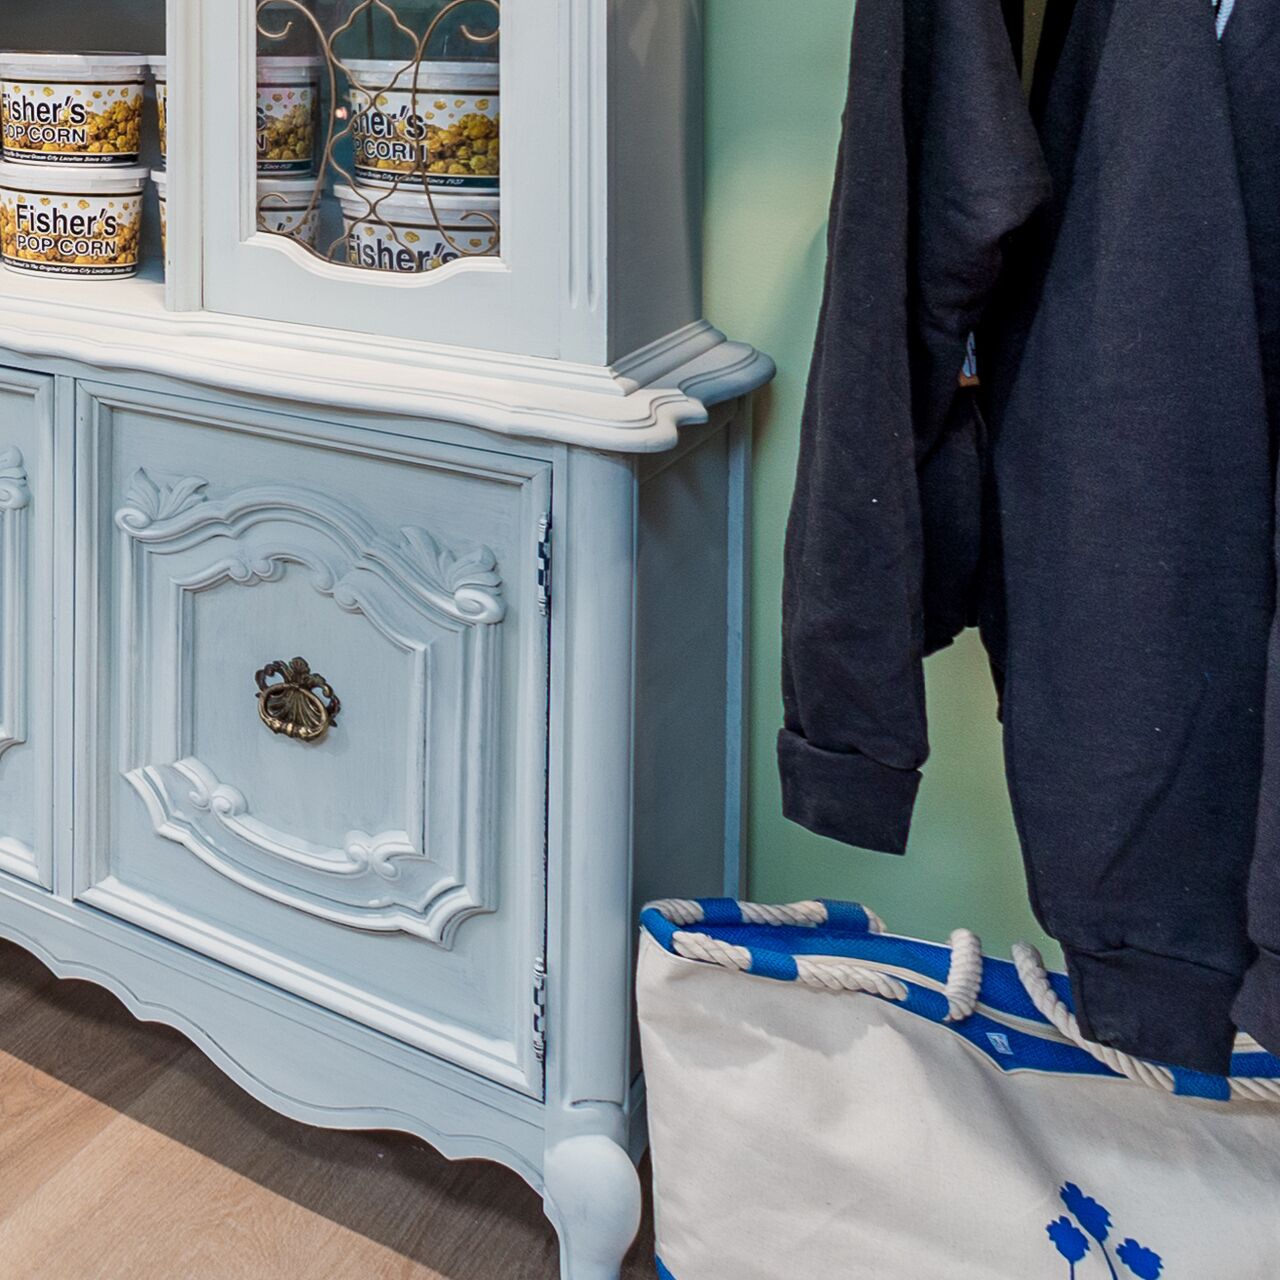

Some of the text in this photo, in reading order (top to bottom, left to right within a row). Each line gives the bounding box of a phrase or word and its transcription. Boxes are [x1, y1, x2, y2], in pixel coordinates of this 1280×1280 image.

[1, 93, 86, 126] Fisher's
[28, 126, 86, 144] CORN
[16, 203, 117, 237] Fisher's
[17, 235, 116, 256] POP CORN
